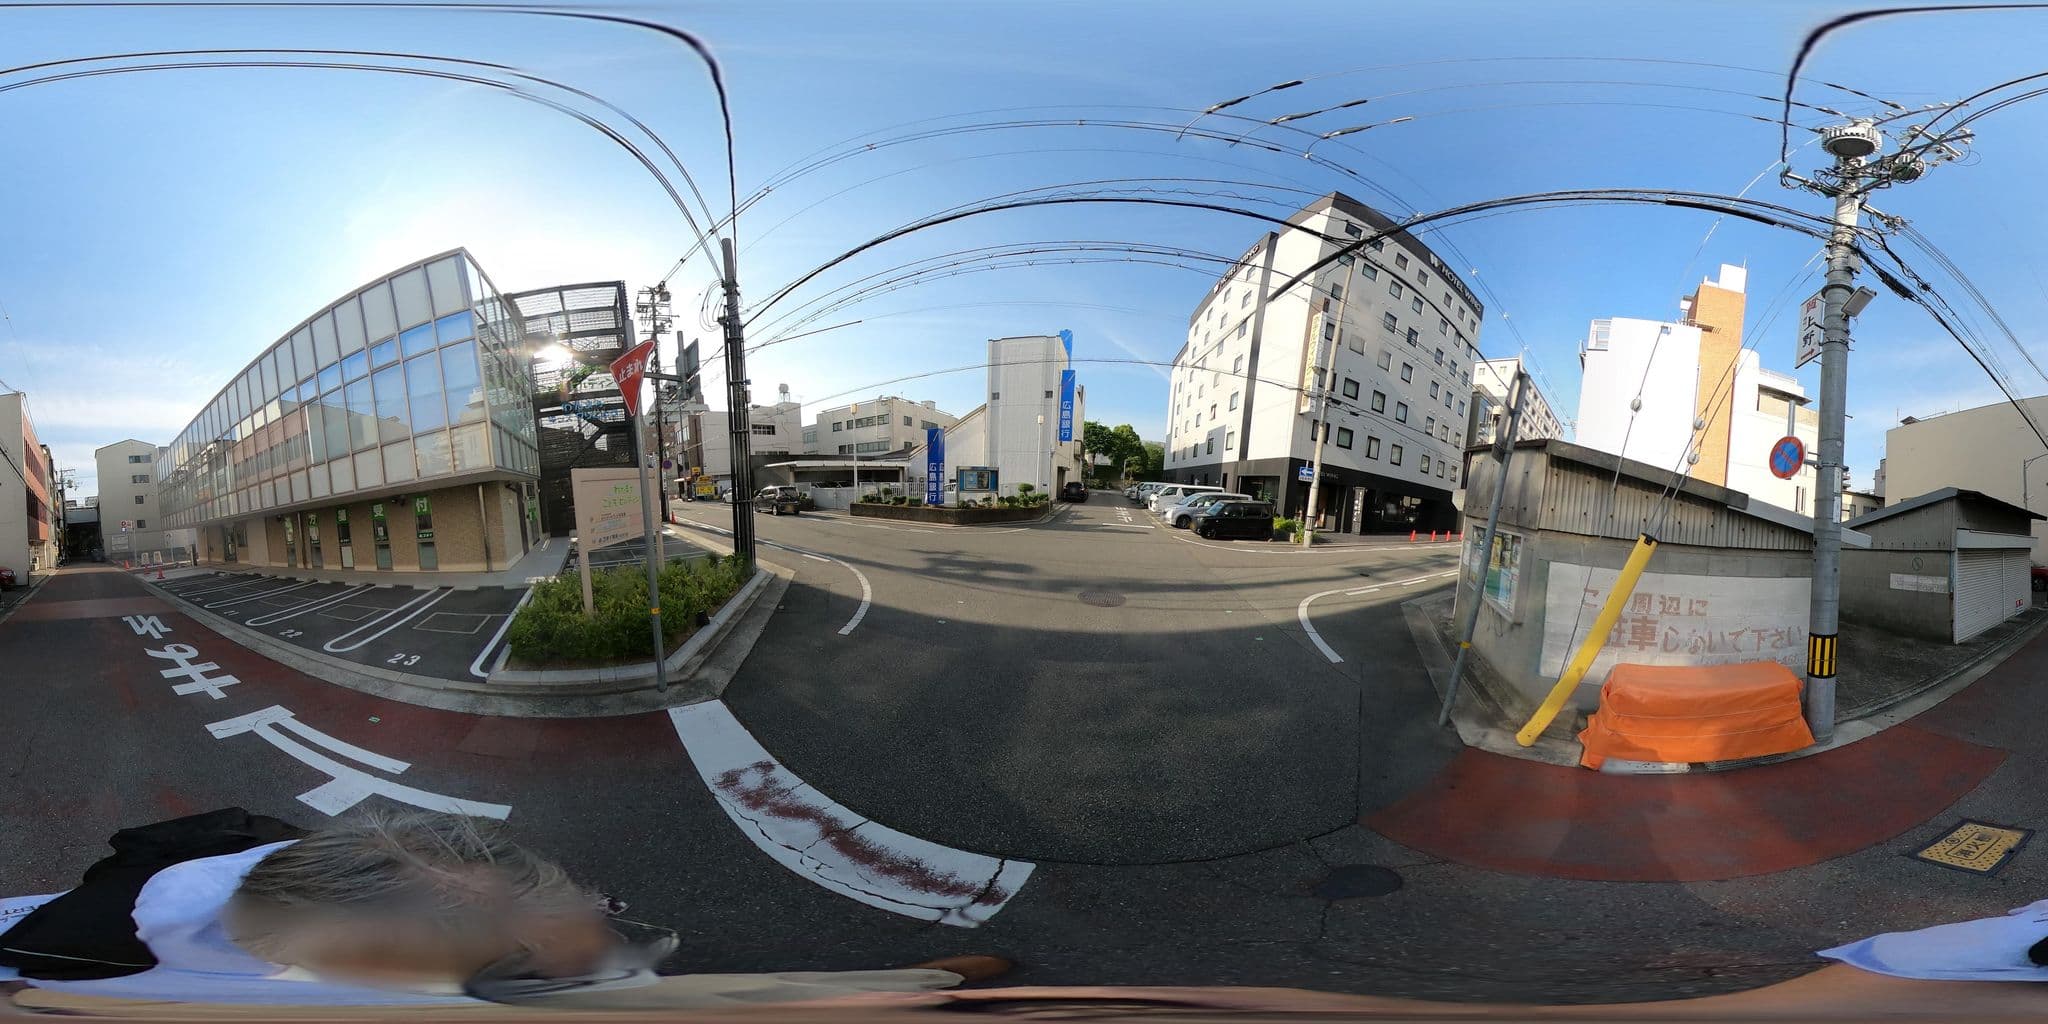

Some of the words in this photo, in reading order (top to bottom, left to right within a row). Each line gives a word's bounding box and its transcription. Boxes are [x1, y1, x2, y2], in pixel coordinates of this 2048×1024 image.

[1441, 264, 1464, 292] HOTEL
[1464, 286, 1481, 312] WING
[618, 358, 644, 384] 止まれ
[1060, 400, 1072, 438] 広島銀行
[928, 462, 937, 502] 広島銀行
[415, 497, 428, 512] 付
[1583, 587, 1709, 616] こ周辺に
[278, 628, 304, 639] 22
[386, 652, 421, 667] 23
